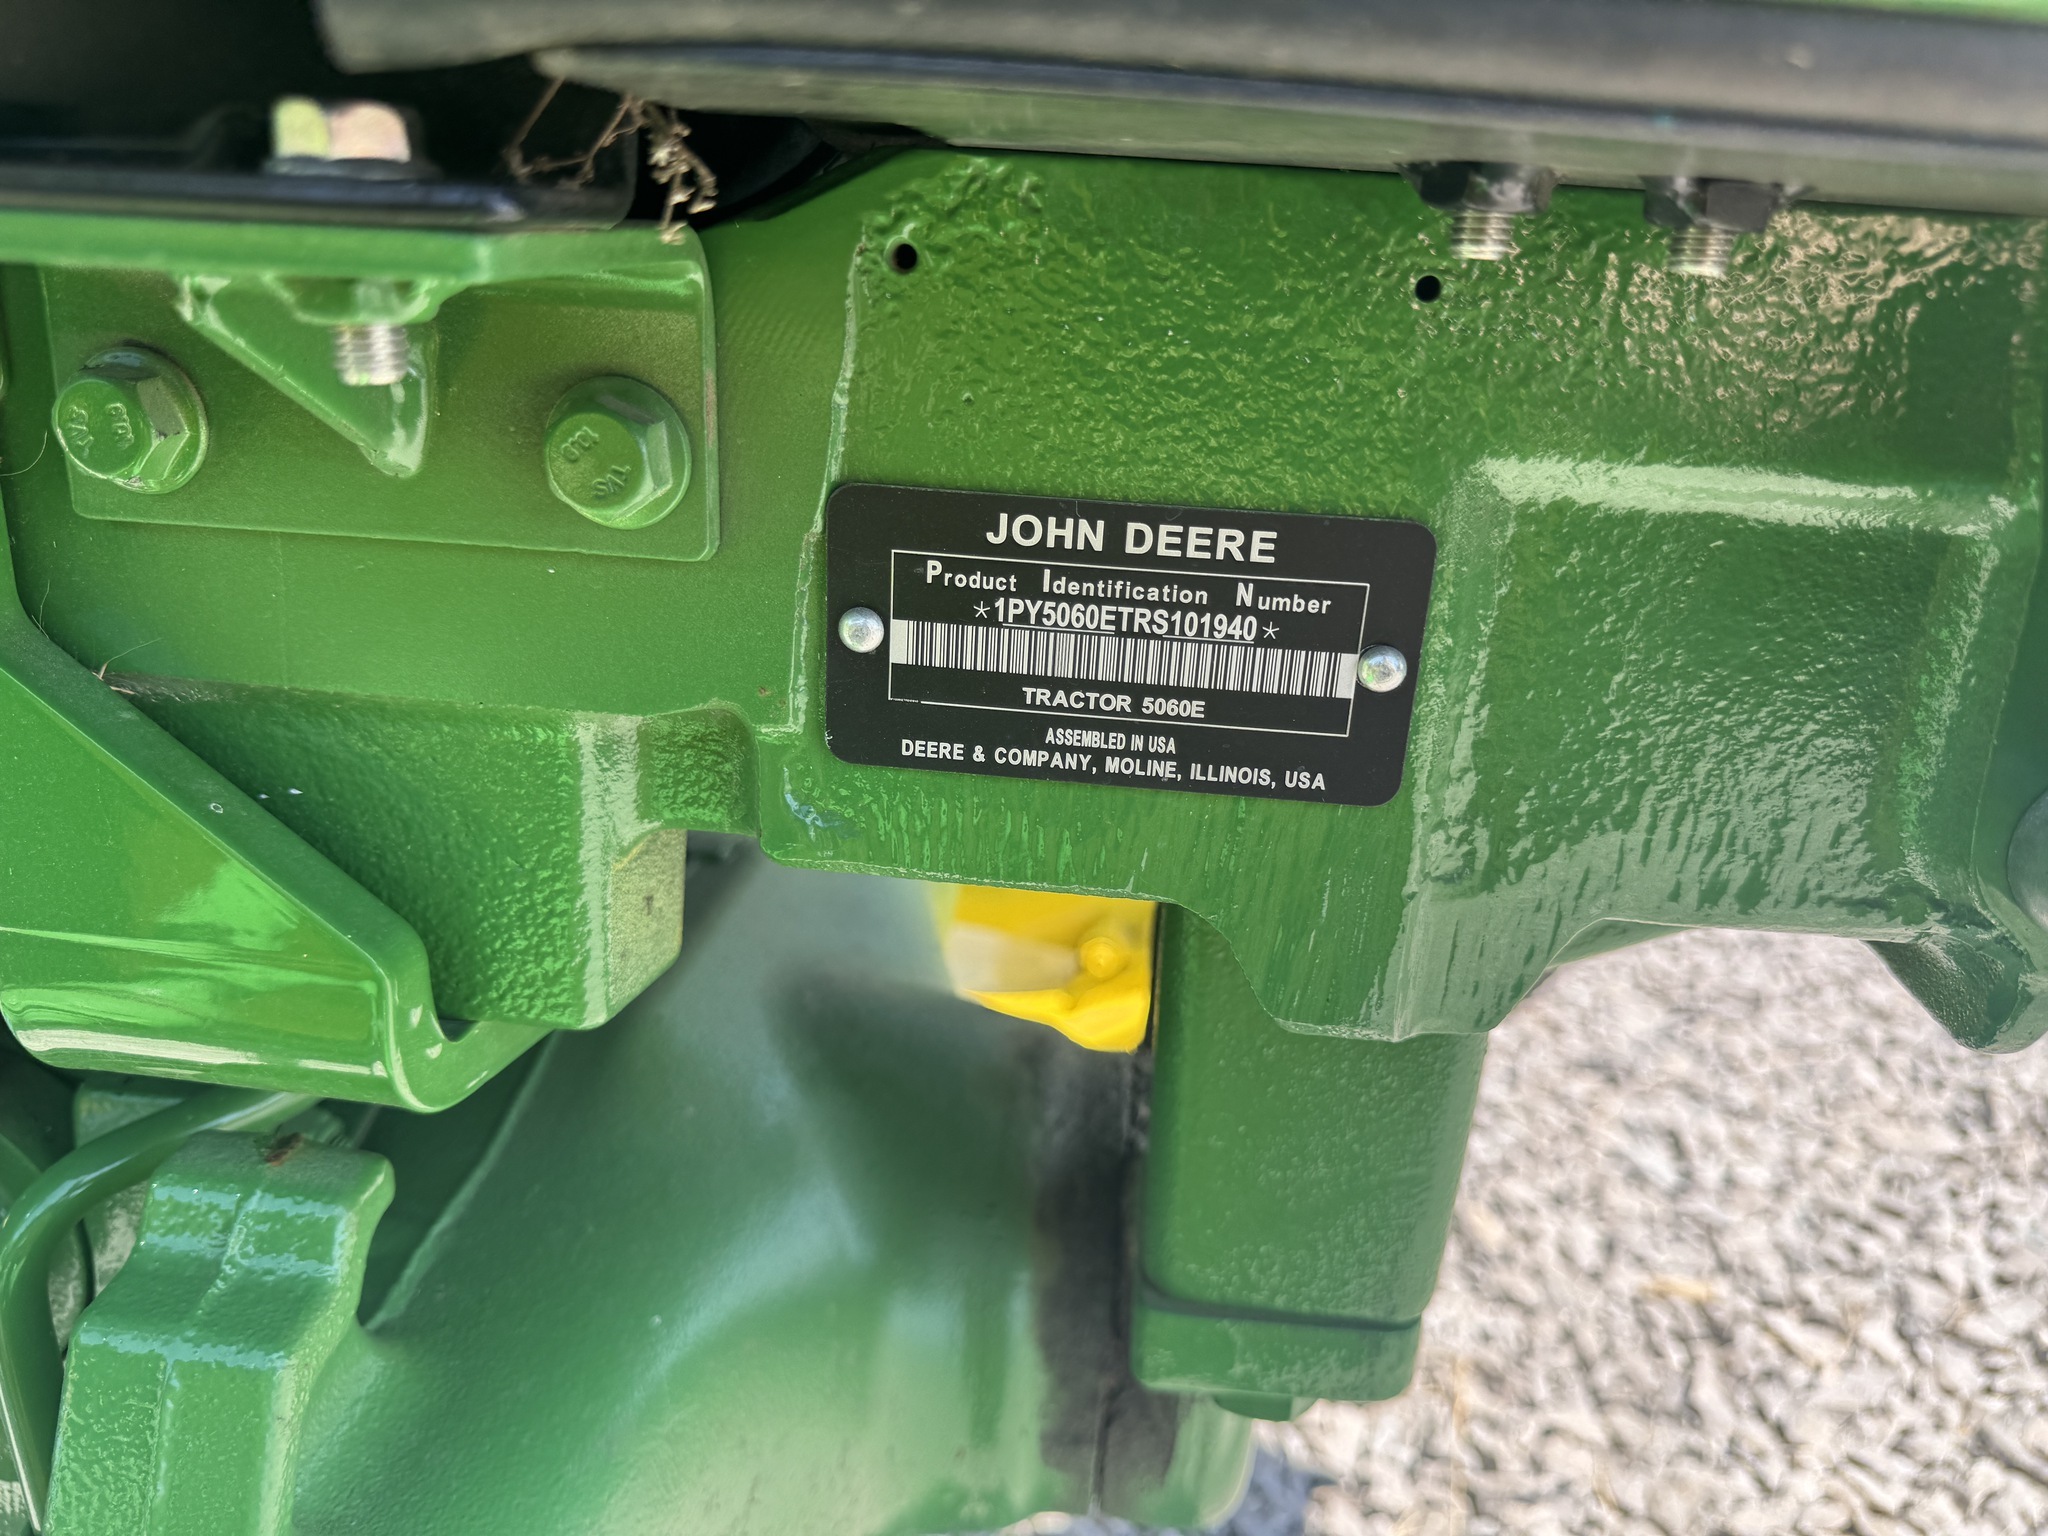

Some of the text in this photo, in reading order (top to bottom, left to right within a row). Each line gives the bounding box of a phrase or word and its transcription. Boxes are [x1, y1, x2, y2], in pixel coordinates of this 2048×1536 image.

[986, 512, 1278, 564] JOHN DEERE
[926, 560, 1332, 614] Product Identification Number
[1022, 687, 1206, 719] TRACTOR 5060E
[901, 738, 1326, 791] DEERE & COMPANY, MOLINE, ILLINOIS, USA
[1045, 727, 1176, 754] ASSEMBLED IN USA
